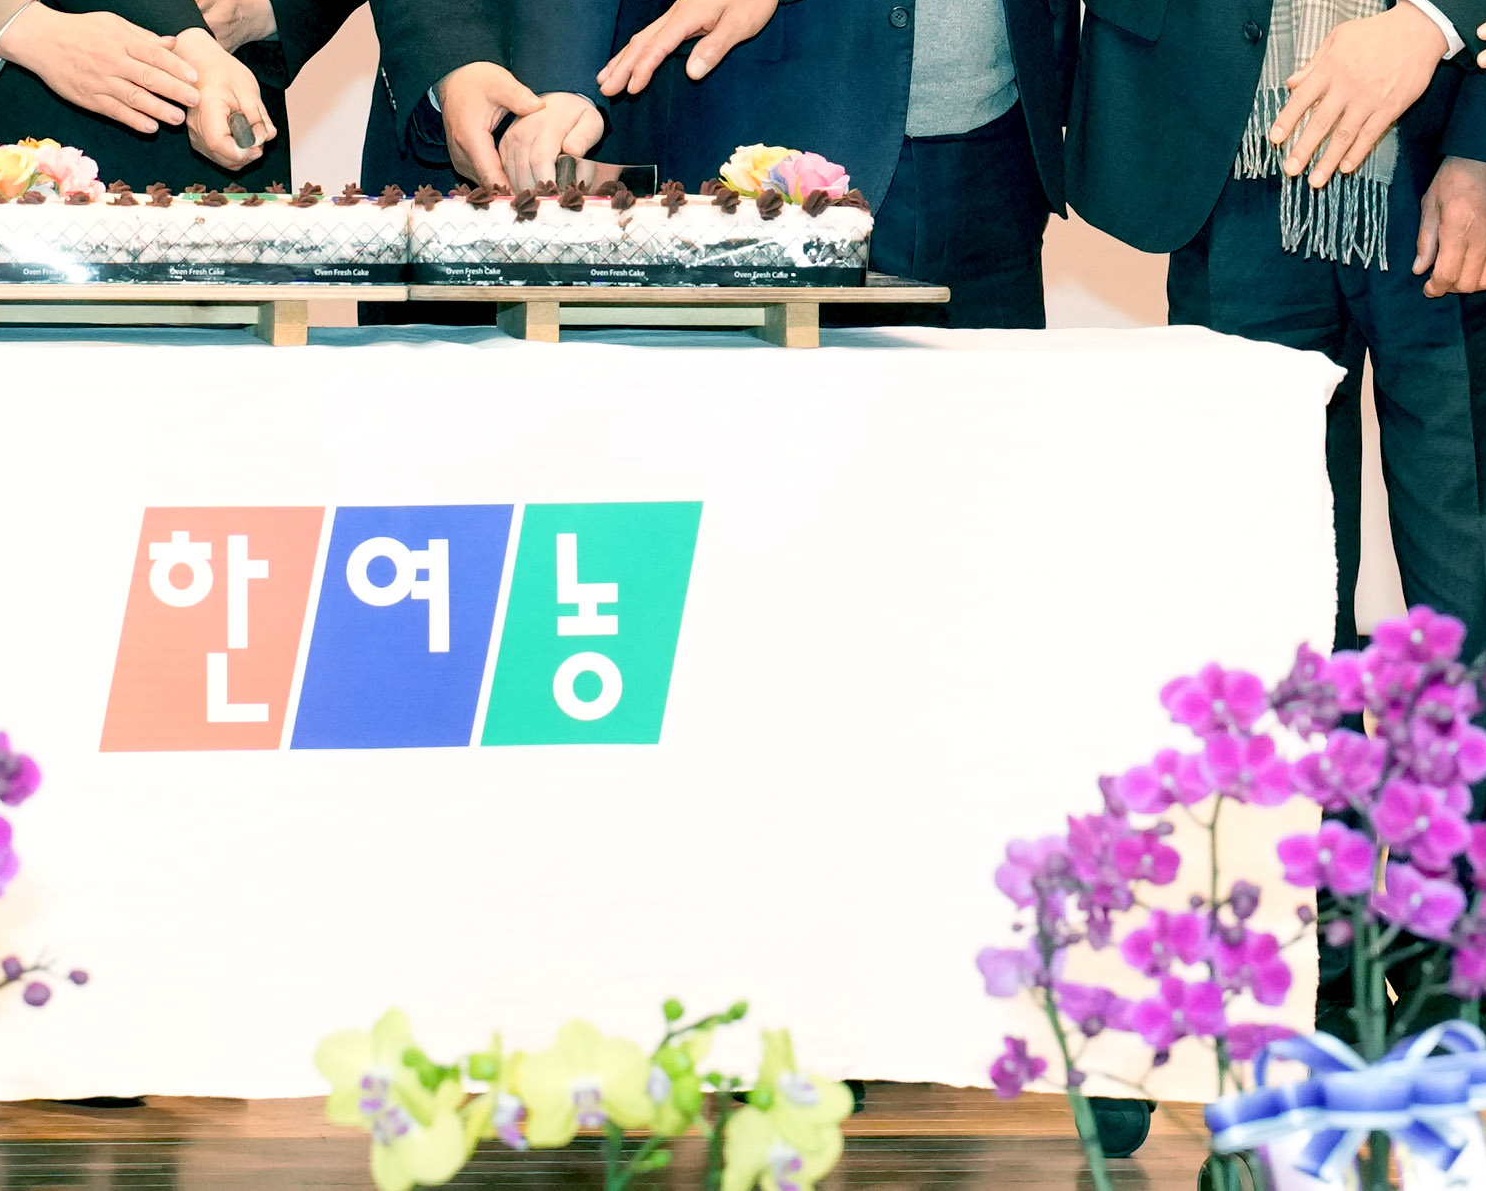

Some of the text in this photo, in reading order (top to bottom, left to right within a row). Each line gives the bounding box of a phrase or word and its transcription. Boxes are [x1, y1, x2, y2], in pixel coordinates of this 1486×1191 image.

[169, 267, 188, 275] Oven
[188, 267, 207, 275] Fresh
[314, 268, 369, 276] Oven Fresh Cake
[446, 267, 501, 275] Oven Fresh Cake
[590, 268, 608, 276] Oven
[609, 268, 628, 276] Fresh
[734, 270, 752, 278] Oven
[753, 270, 771, 278] Fresh
